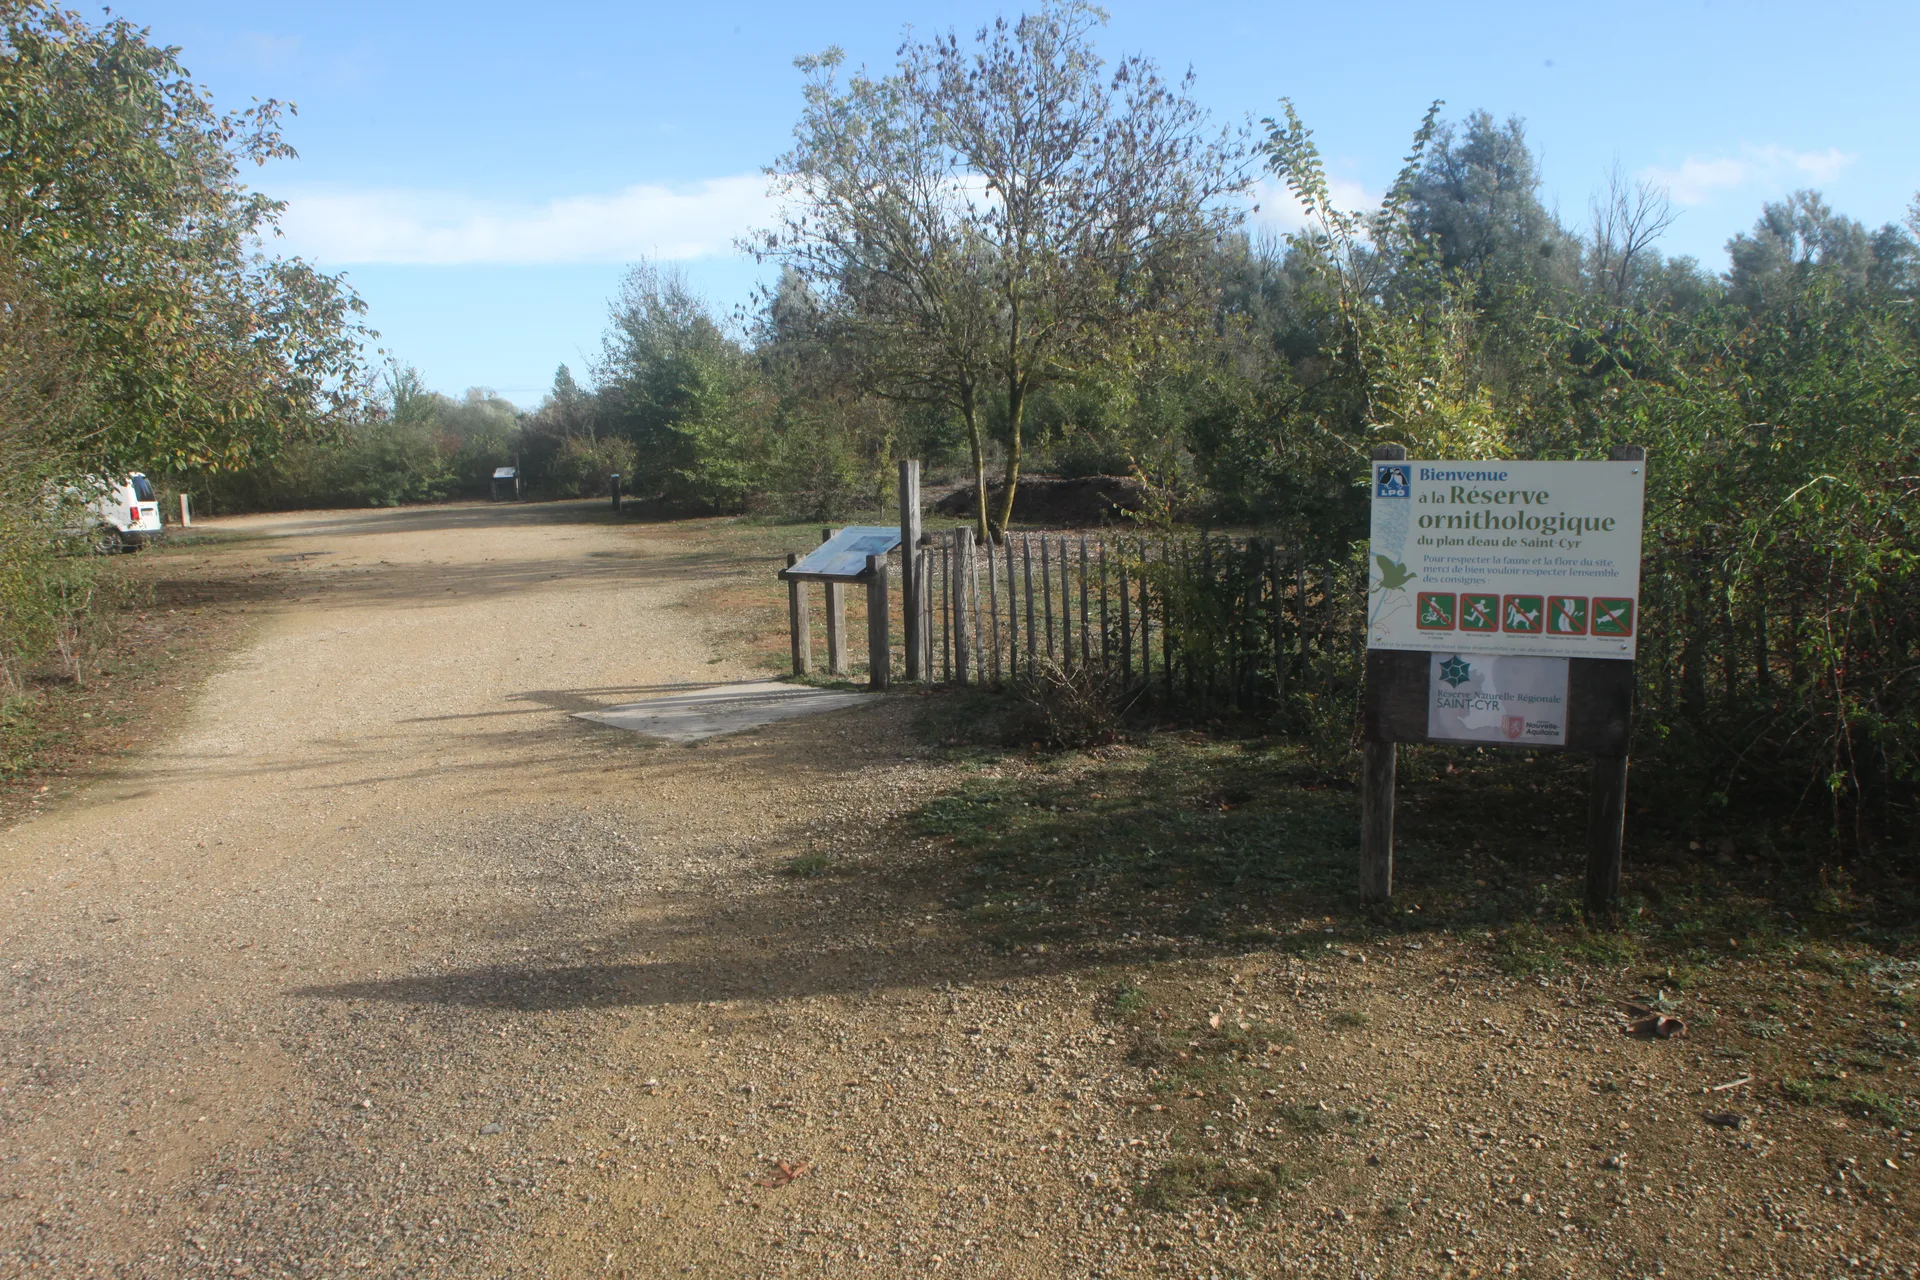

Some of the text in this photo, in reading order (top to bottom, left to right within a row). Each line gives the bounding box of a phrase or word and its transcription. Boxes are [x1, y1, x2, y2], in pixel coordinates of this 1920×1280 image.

[1420, 468, 1508, 481] Bienvenue
[1381, 489, 1406, 497] LPO
[1418, 485, 1549, 505] à la Réserve
[1418, 510, 1616, 536] ornithologique
[1417, 535, 1582, 550] du plan d'eau de Saint-Cyr
[1423, 554, 1445, 563] Pour
[1447, 555, 1490, 565] respecter
[1492, 556, 1501, 564] la
[1503, 556, 1531, 565] faune
[1543, 557, 1553, 565] la
[1555, 557, 1579, 566] flore
[1580, 558, 1593, 566] du
[1451, 565, 1463, 573] de
[1465, 566, 1485, 574] bien
[1486, 566, 1520, 574] vouloir
[1522, 568, 1567, 577] respecter
[1422, 575, 1438, 583] des
[1437, 690, 1561, 704] Réserve Naturelle Régionale
[1437, 698, 1500, 711] SAINT-CYR
[1526, 722, 1560, 730] Nouvelle-
[1526, 729, 1560, 737] Aquitaine
